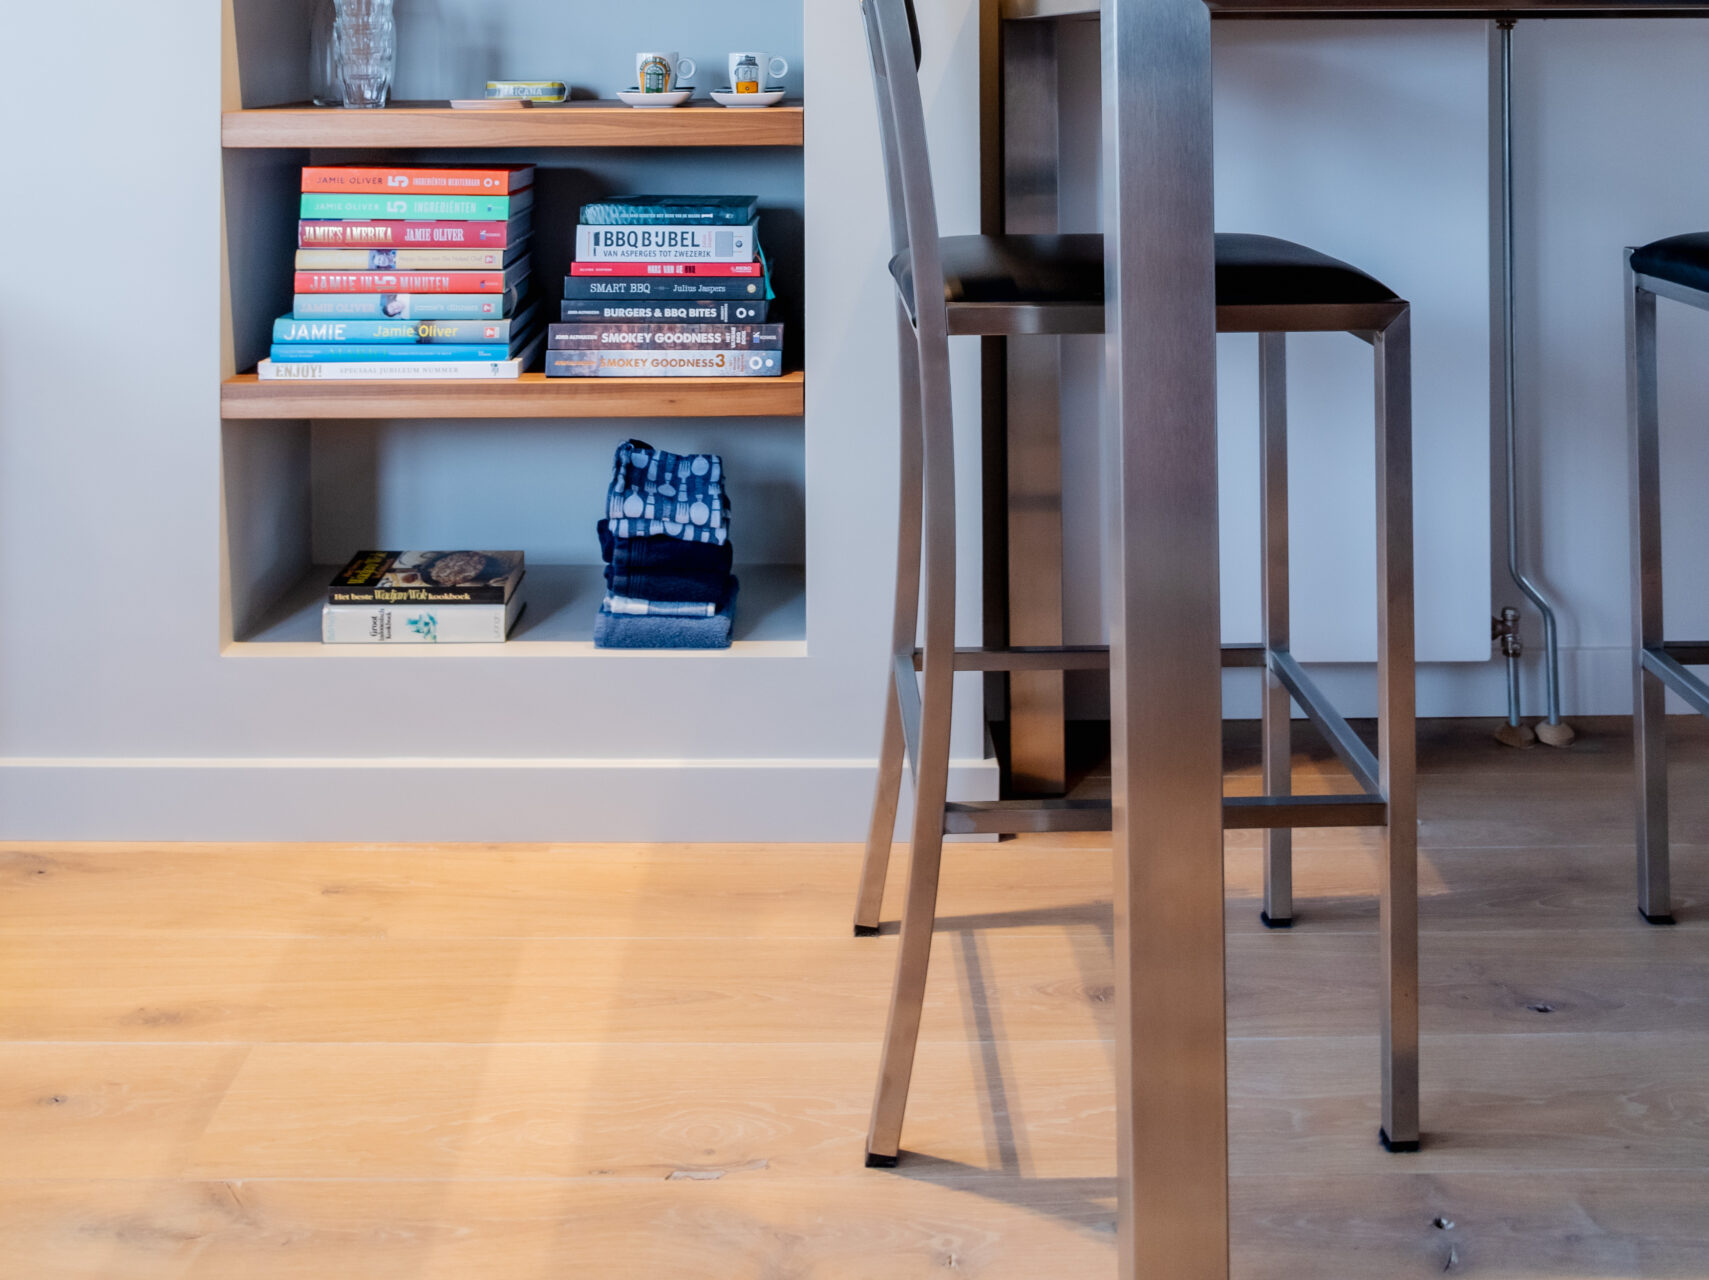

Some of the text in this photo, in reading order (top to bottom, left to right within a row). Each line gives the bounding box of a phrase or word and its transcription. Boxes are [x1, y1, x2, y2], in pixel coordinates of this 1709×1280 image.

[316, 176, 344, 185] JAMIE
[349, 176, 383, 185] OLIVER
[315, 202, 343, 210] JAMIE
[344, 202, 380, 210] OLIVER
[386, 201, 407, 213] 5
[303, 226, 393, 243] JAMIE'S AMERIKA
[404, 228, 465, 242] JAMIE OLIVER
[603, 230, 638, 248] BBQ
[674, 250, 711, 258] ZWEZERIK
[310, 276, 356, 291] JAMIE
[360, 276, 373, 291] IN
[400, 276, 449, 290] MINUTEN
[590, 283, 651, 294] SMART BBQ
[673, 284, 726, 294] Julius Jaspers
[336, 303, 376, 313] OLIVER
[604, 308, 652, 318] BURGERS
[654, 308, 663, 317] &
[664, 308, 687, 318] BBQ
[688, 308, 717, 318] BITES
[283, 324, 346, 340] JAMIE
[373, 324, 459, 337] Jamie Oliver
[601, 332, 722, 343] SMOKEY GOODNESS
[600, 358, 648, 368] SMOKEY
[651, 358, 714, 368] GOODNESS
[715, 353, 726, 368] 3
[275, 365, 323, 378] ENJOY!
